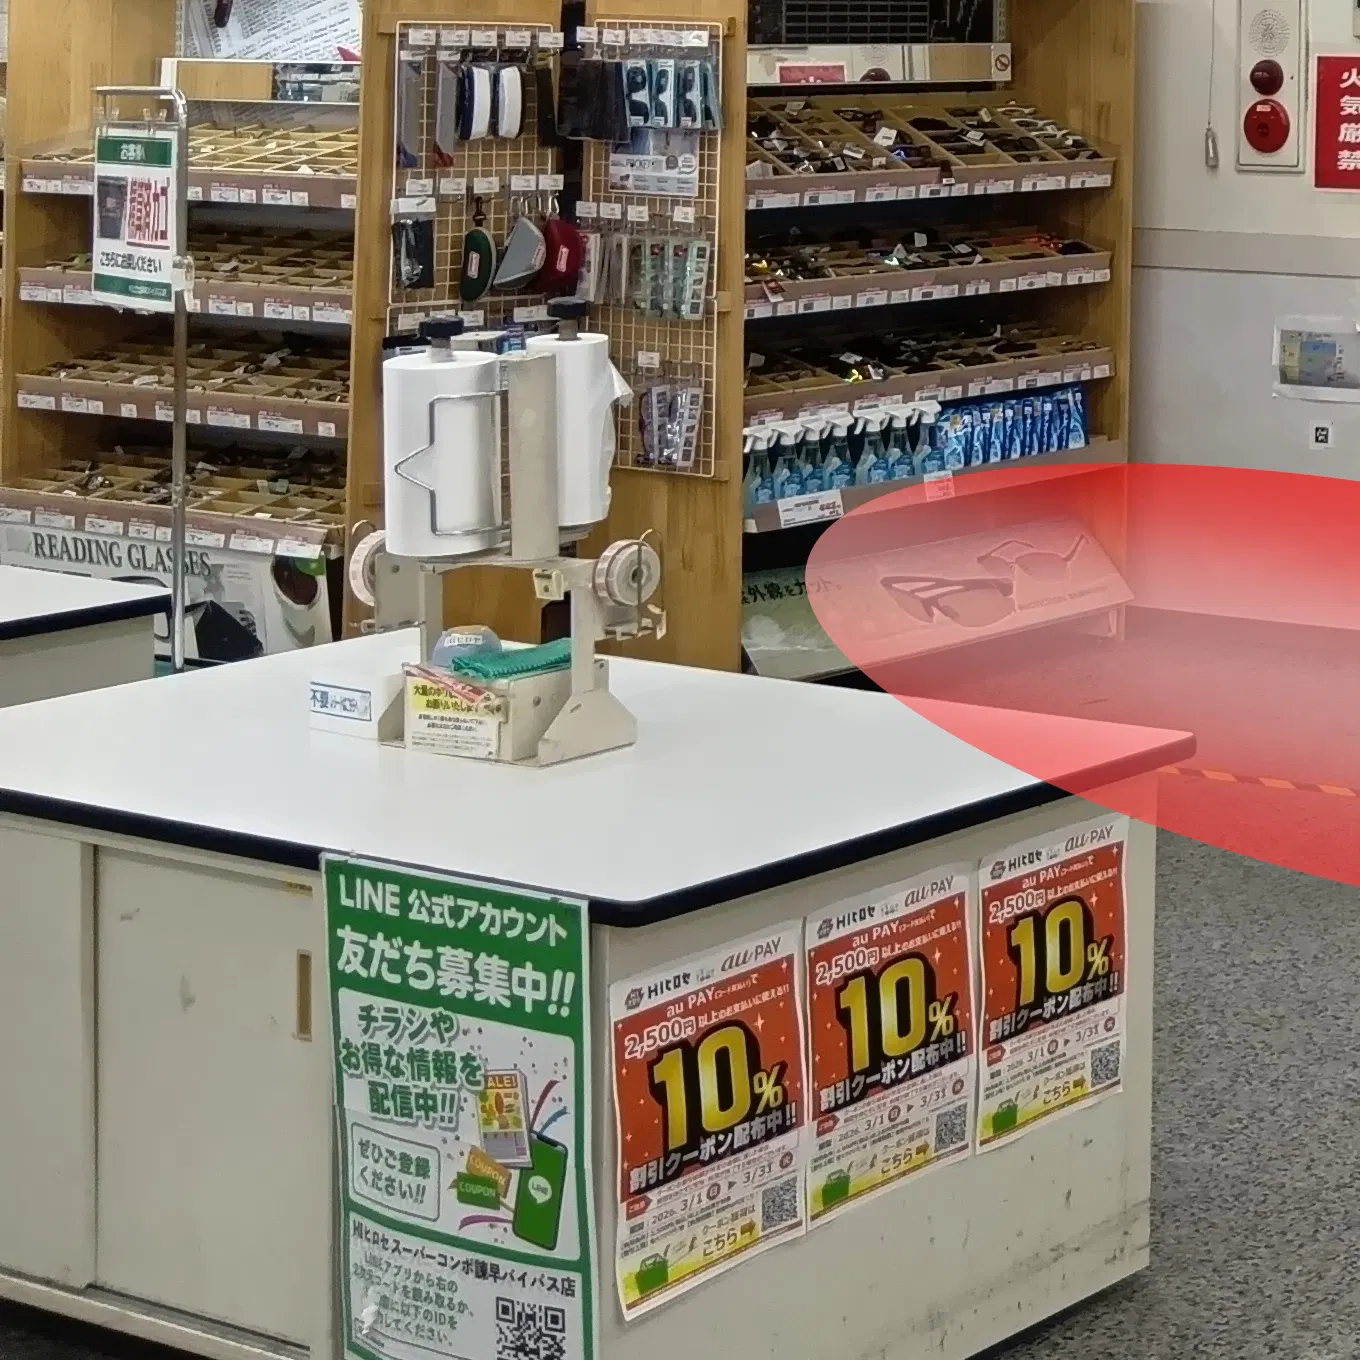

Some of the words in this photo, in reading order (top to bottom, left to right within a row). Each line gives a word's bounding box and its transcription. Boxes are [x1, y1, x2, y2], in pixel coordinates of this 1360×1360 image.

[30, 530, 123, 569] READING
[1065, 834, 1089, 853] au
[1090, 825, 1114, 843] PAY
[338, 873, 401, 917] LINE
[407, 888, 568, 947] 公式アカウント
[904, 887, 930, 908] au
[931, 875, 954, 898] PAY
[336, 924, 576, 1018] 友だち募集中!!
[721, 949, 752, 973] au
[754, 936, 782, 962] PAY
[1011, 900, 1109, 1007] 10%
[357, 1003, 456, 1045] チラシや
[840, 957, 955, 1073] 10%
[340, 1036, 482, 1087] お得な情報を
[367, 1080, 457, 1124] 配信中!!
[653, 1025, 784, 1152] 10%
[1043, 1080, 1071, 1106] こちら
[357, 1138, 431, 1179] ぜひご登録
[629, 1104, 797, 1194] 割引クーポン配布中!!
[880, 1147, 914, 1176] こちら
[360, 1164, 427, 1205] ください!!
[458, 1180, 497, 1199] COUPON
[702, 1227, 738, 1258] こちら
